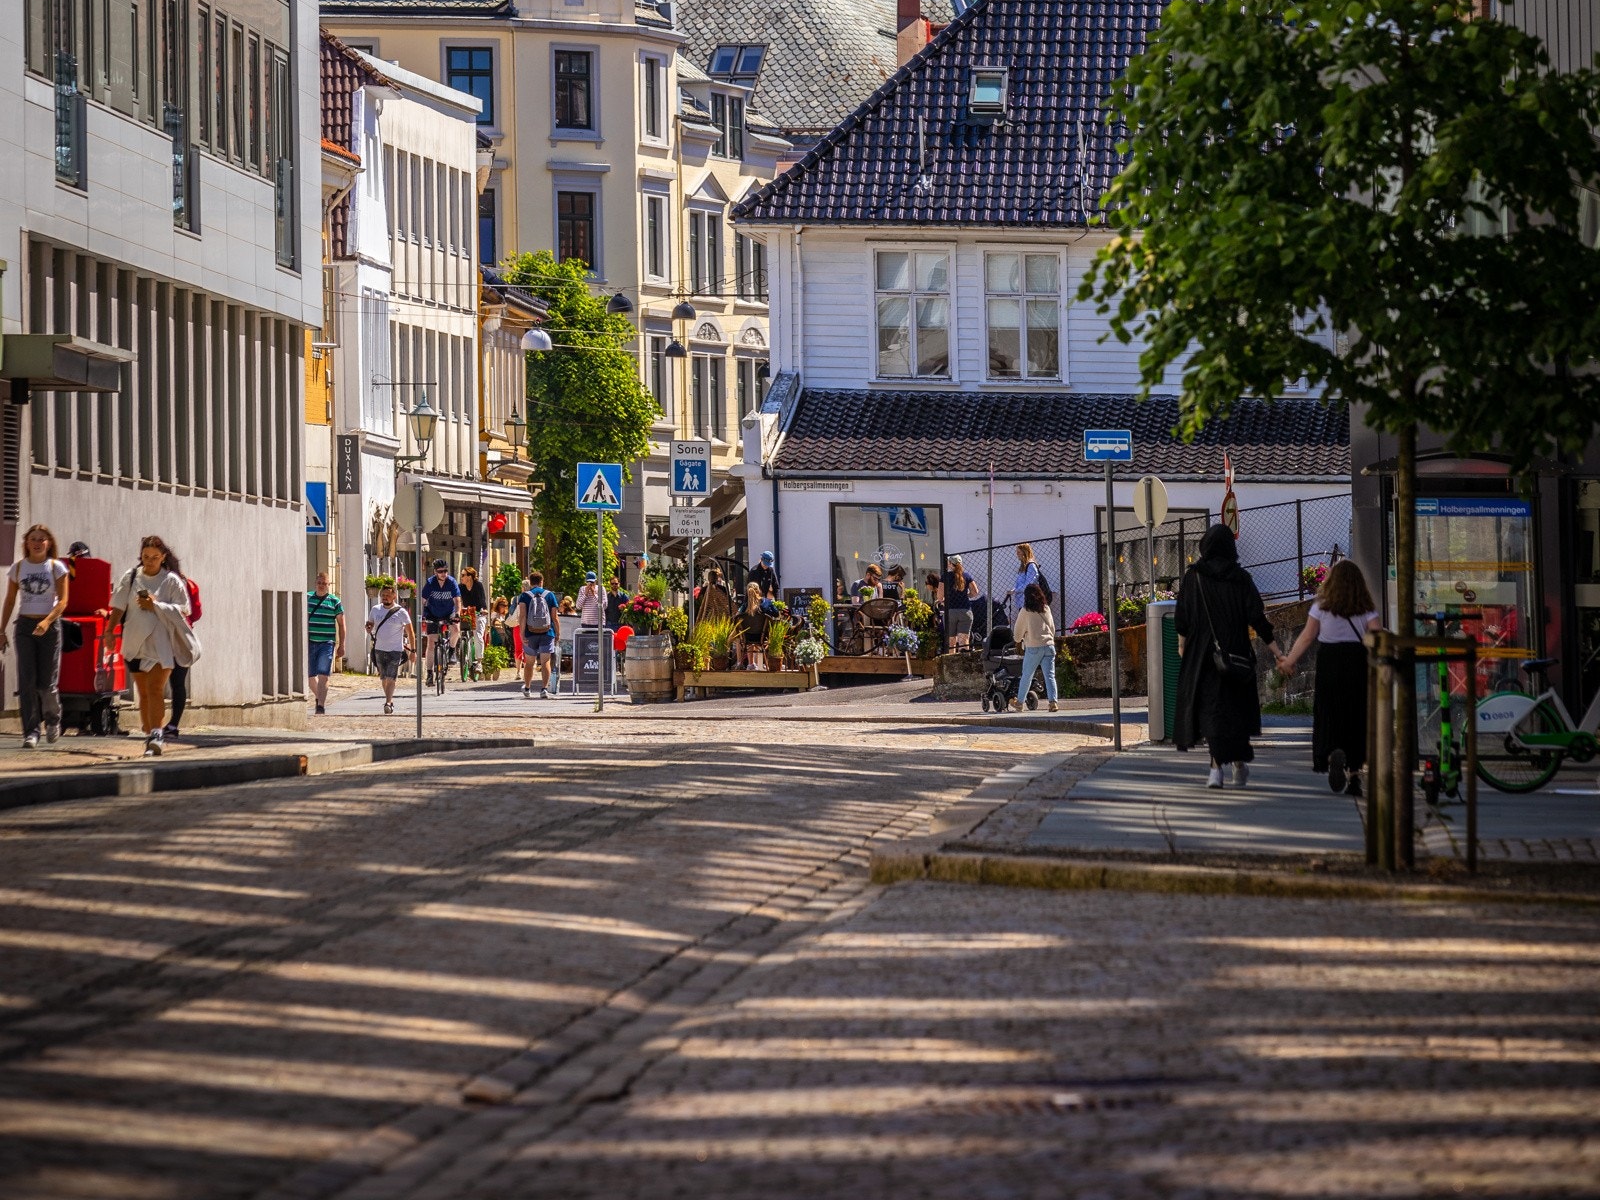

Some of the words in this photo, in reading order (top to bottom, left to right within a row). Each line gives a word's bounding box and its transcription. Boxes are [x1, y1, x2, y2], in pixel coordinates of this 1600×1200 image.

[677, 444, 704, 455] Sone
[679, 460, 702, 468] Gågate
[783, 481, 849, 491] Holbergsallmenningen
[1440, 506, 1526, 515] Holbergsallmenningen
[676, 528, 704, 536] (06-10)
